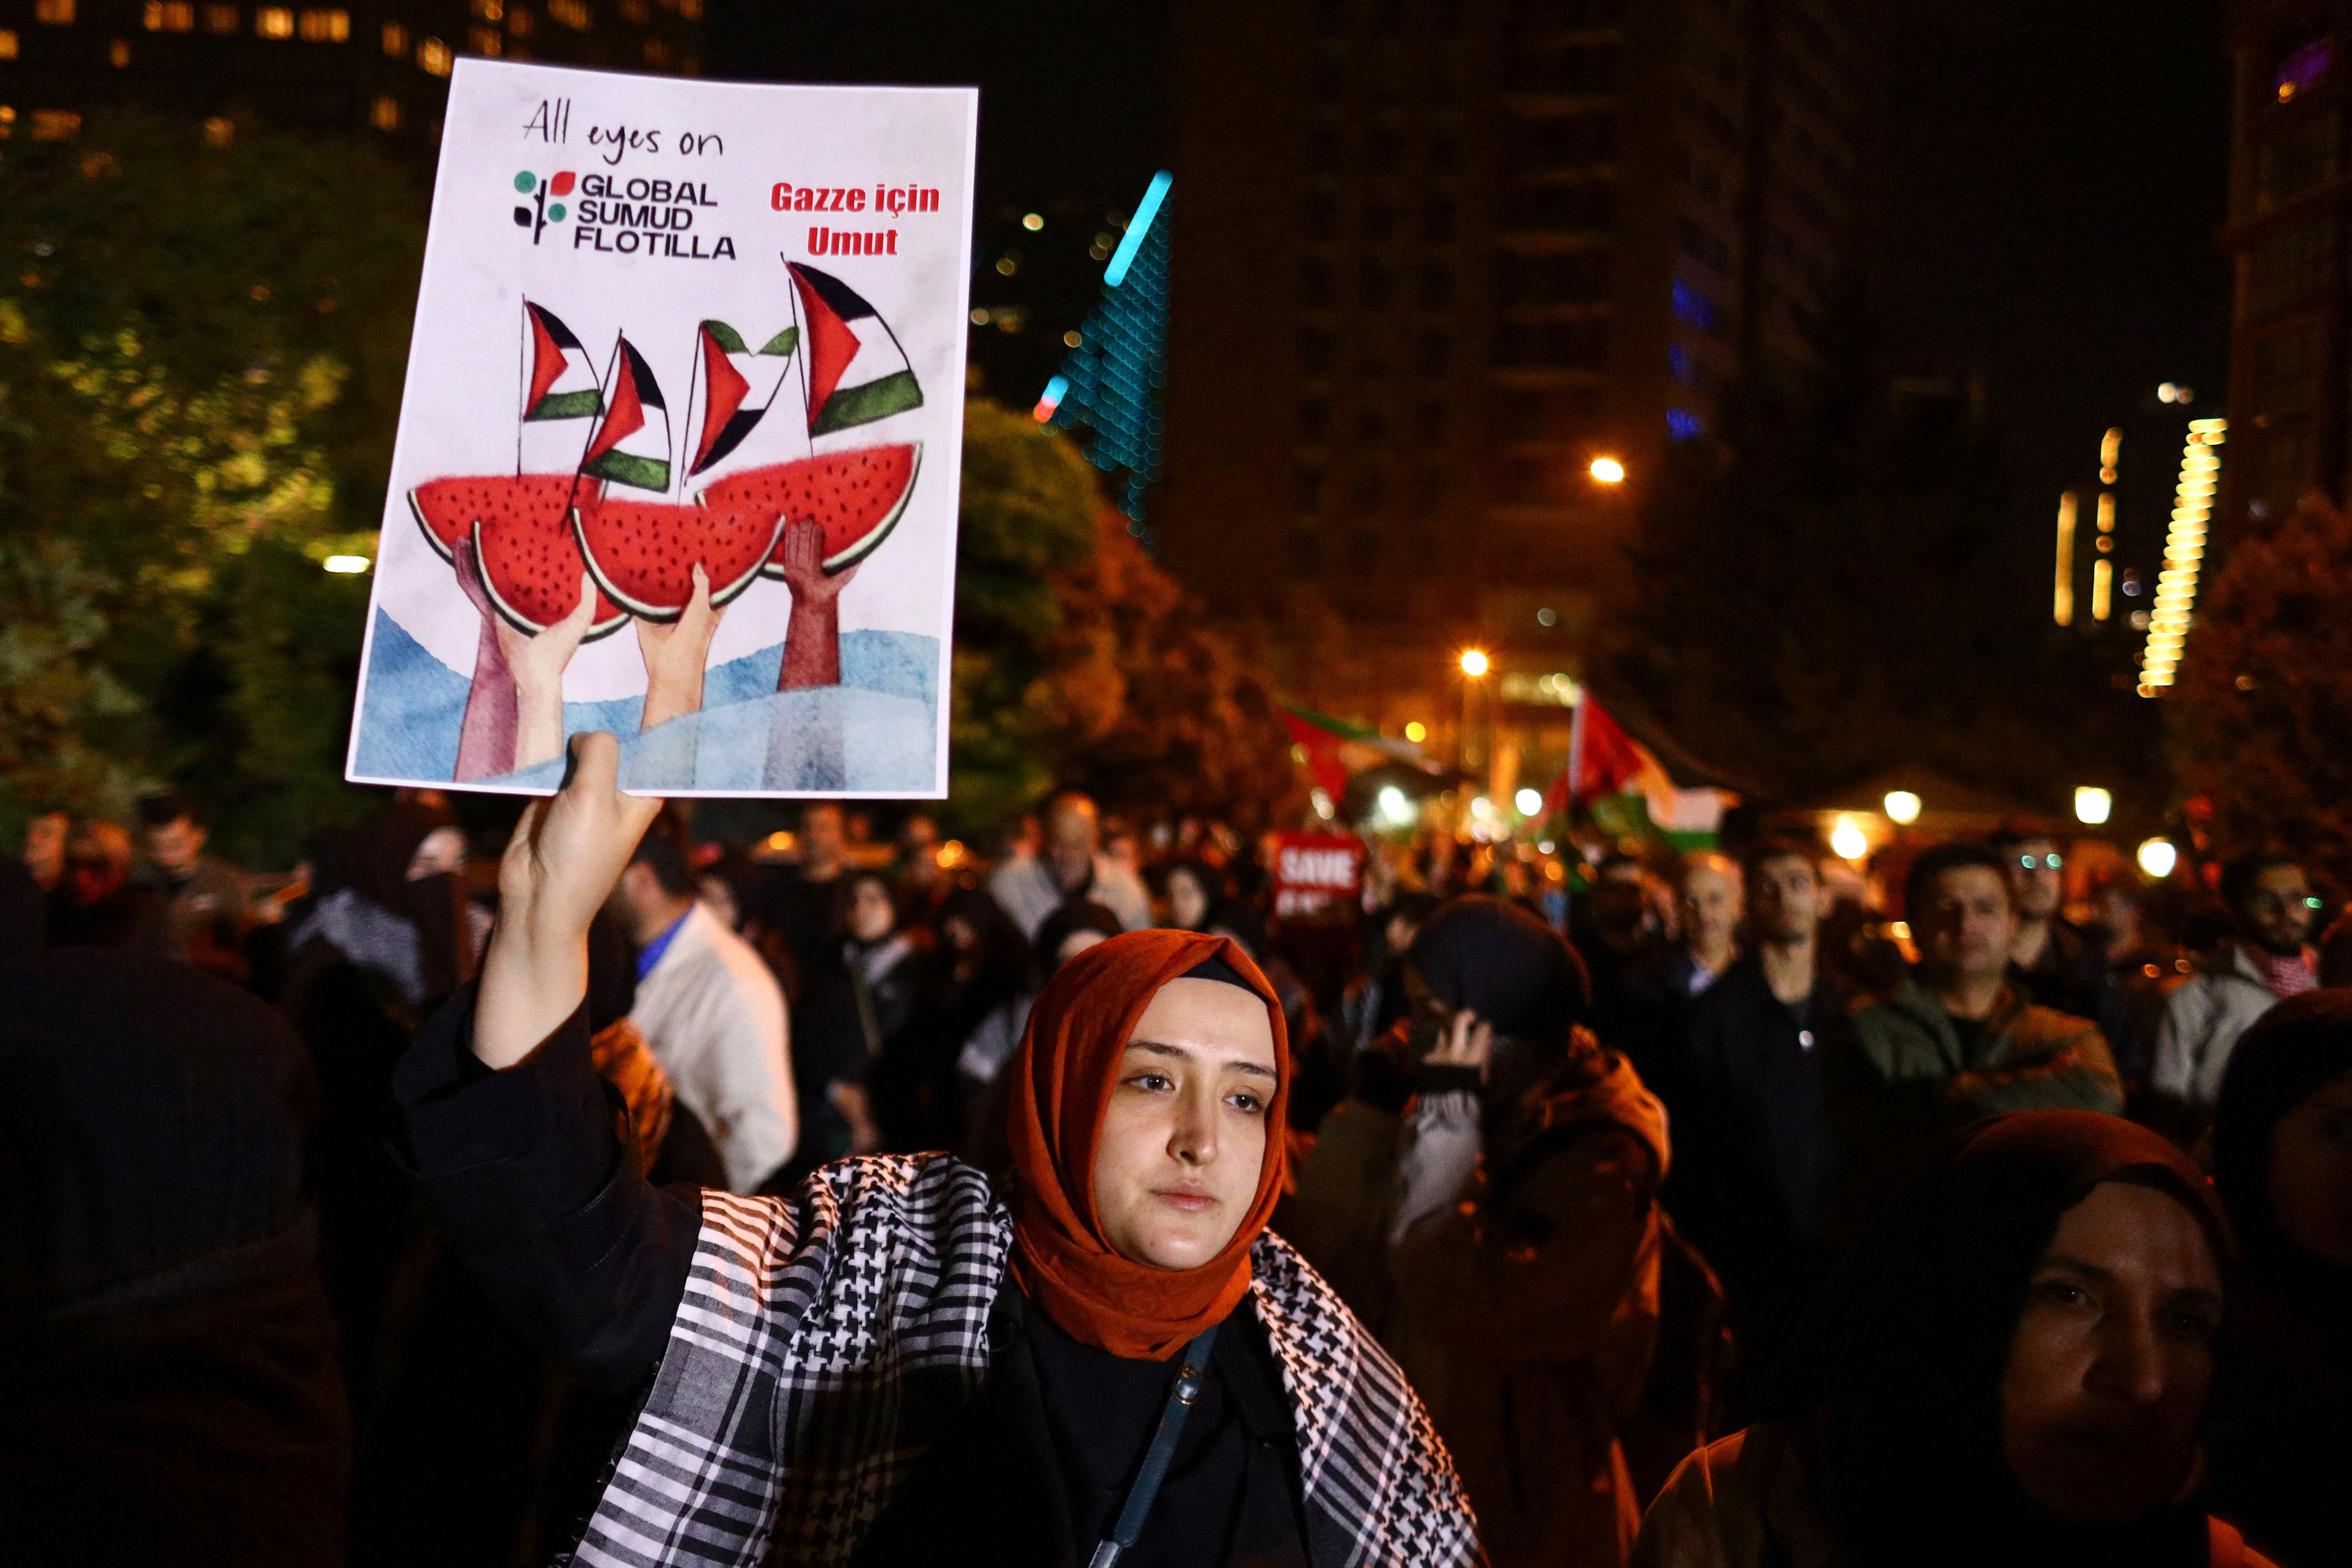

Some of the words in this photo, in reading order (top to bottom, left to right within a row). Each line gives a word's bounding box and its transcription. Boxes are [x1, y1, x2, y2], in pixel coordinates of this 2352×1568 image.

[523, 98, 570, 144] All
[588, 125, 661, 166] eyes
[679, 132, 723, 156] on
[581, 174, 718, 207] GLOBAL
[771, 182, 866, 212] Gazze
[875, 183, 940, 219] için
[577, 200, 693, 231] SUMUD
[574, 226, 736, 260] FLOTILLA
[807, 227, 899, 256] Umut
[1280, 846, 1355, 888] SAVE
